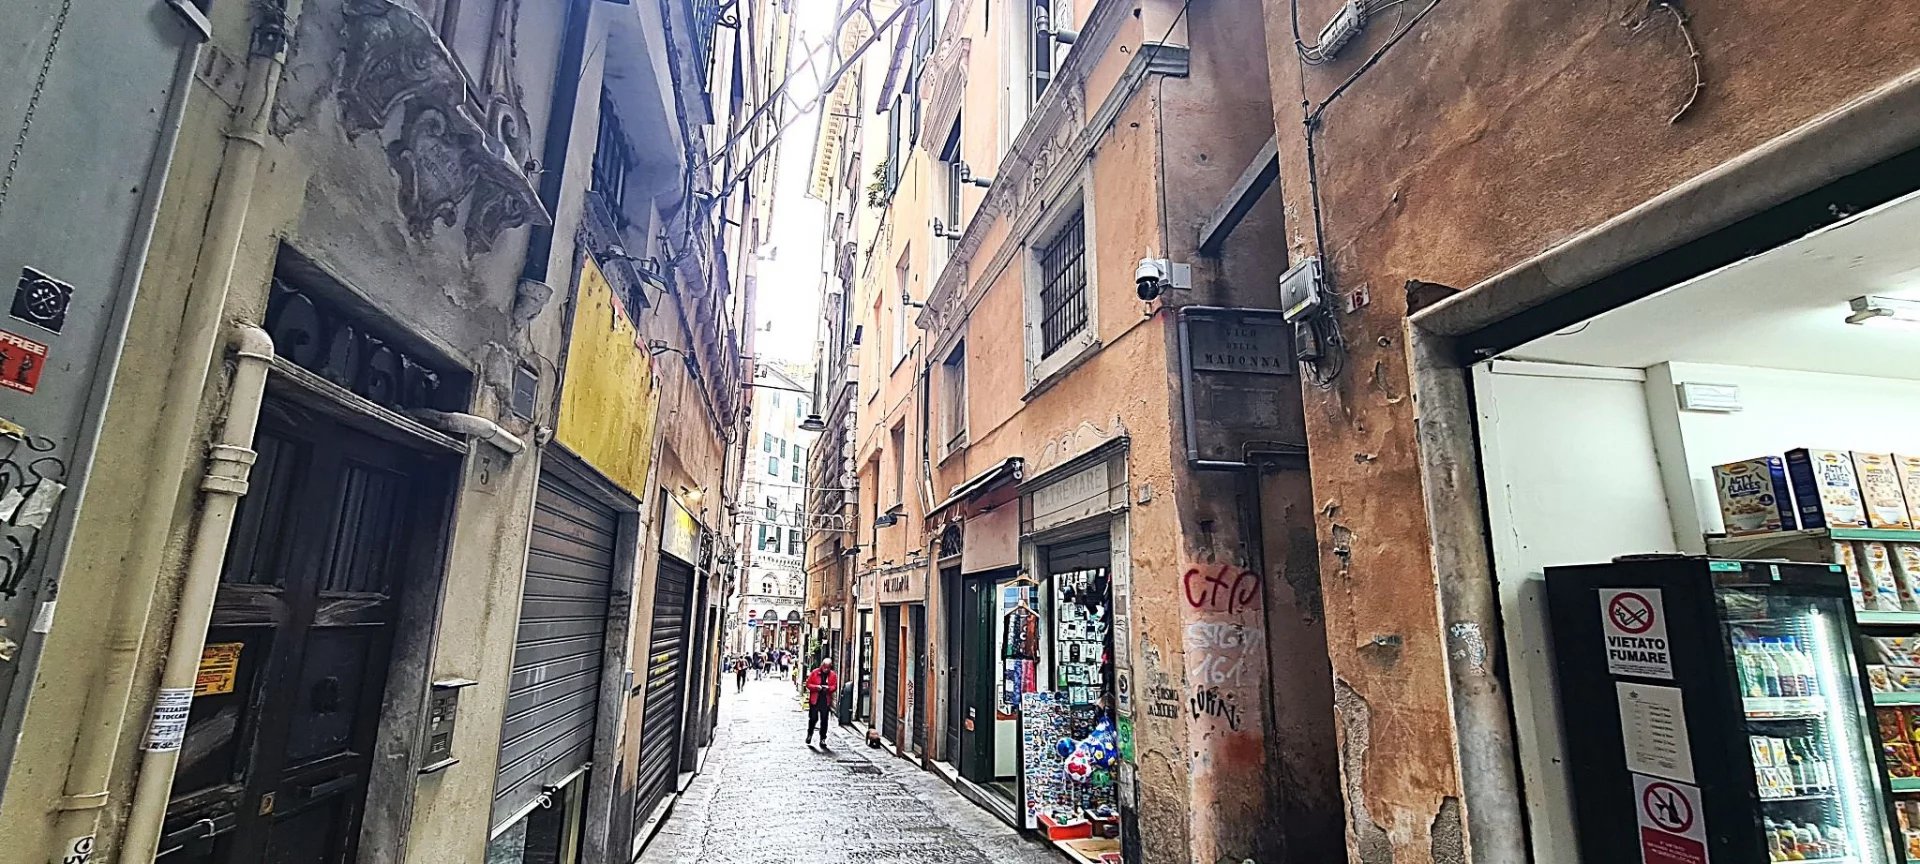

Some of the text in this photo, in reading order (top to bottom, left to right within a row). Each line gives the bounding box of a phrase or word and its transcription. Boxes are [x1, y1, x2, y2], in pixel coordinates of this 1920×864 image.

[0, 331, 46, 356] FREE
[1205, 353, 1281, 368] MADONNA
[480, 458, 491, 486] 3
[1607, 635, 1667, 650] VIETATO
[1609, 649, 1668, 664] FUMARE
